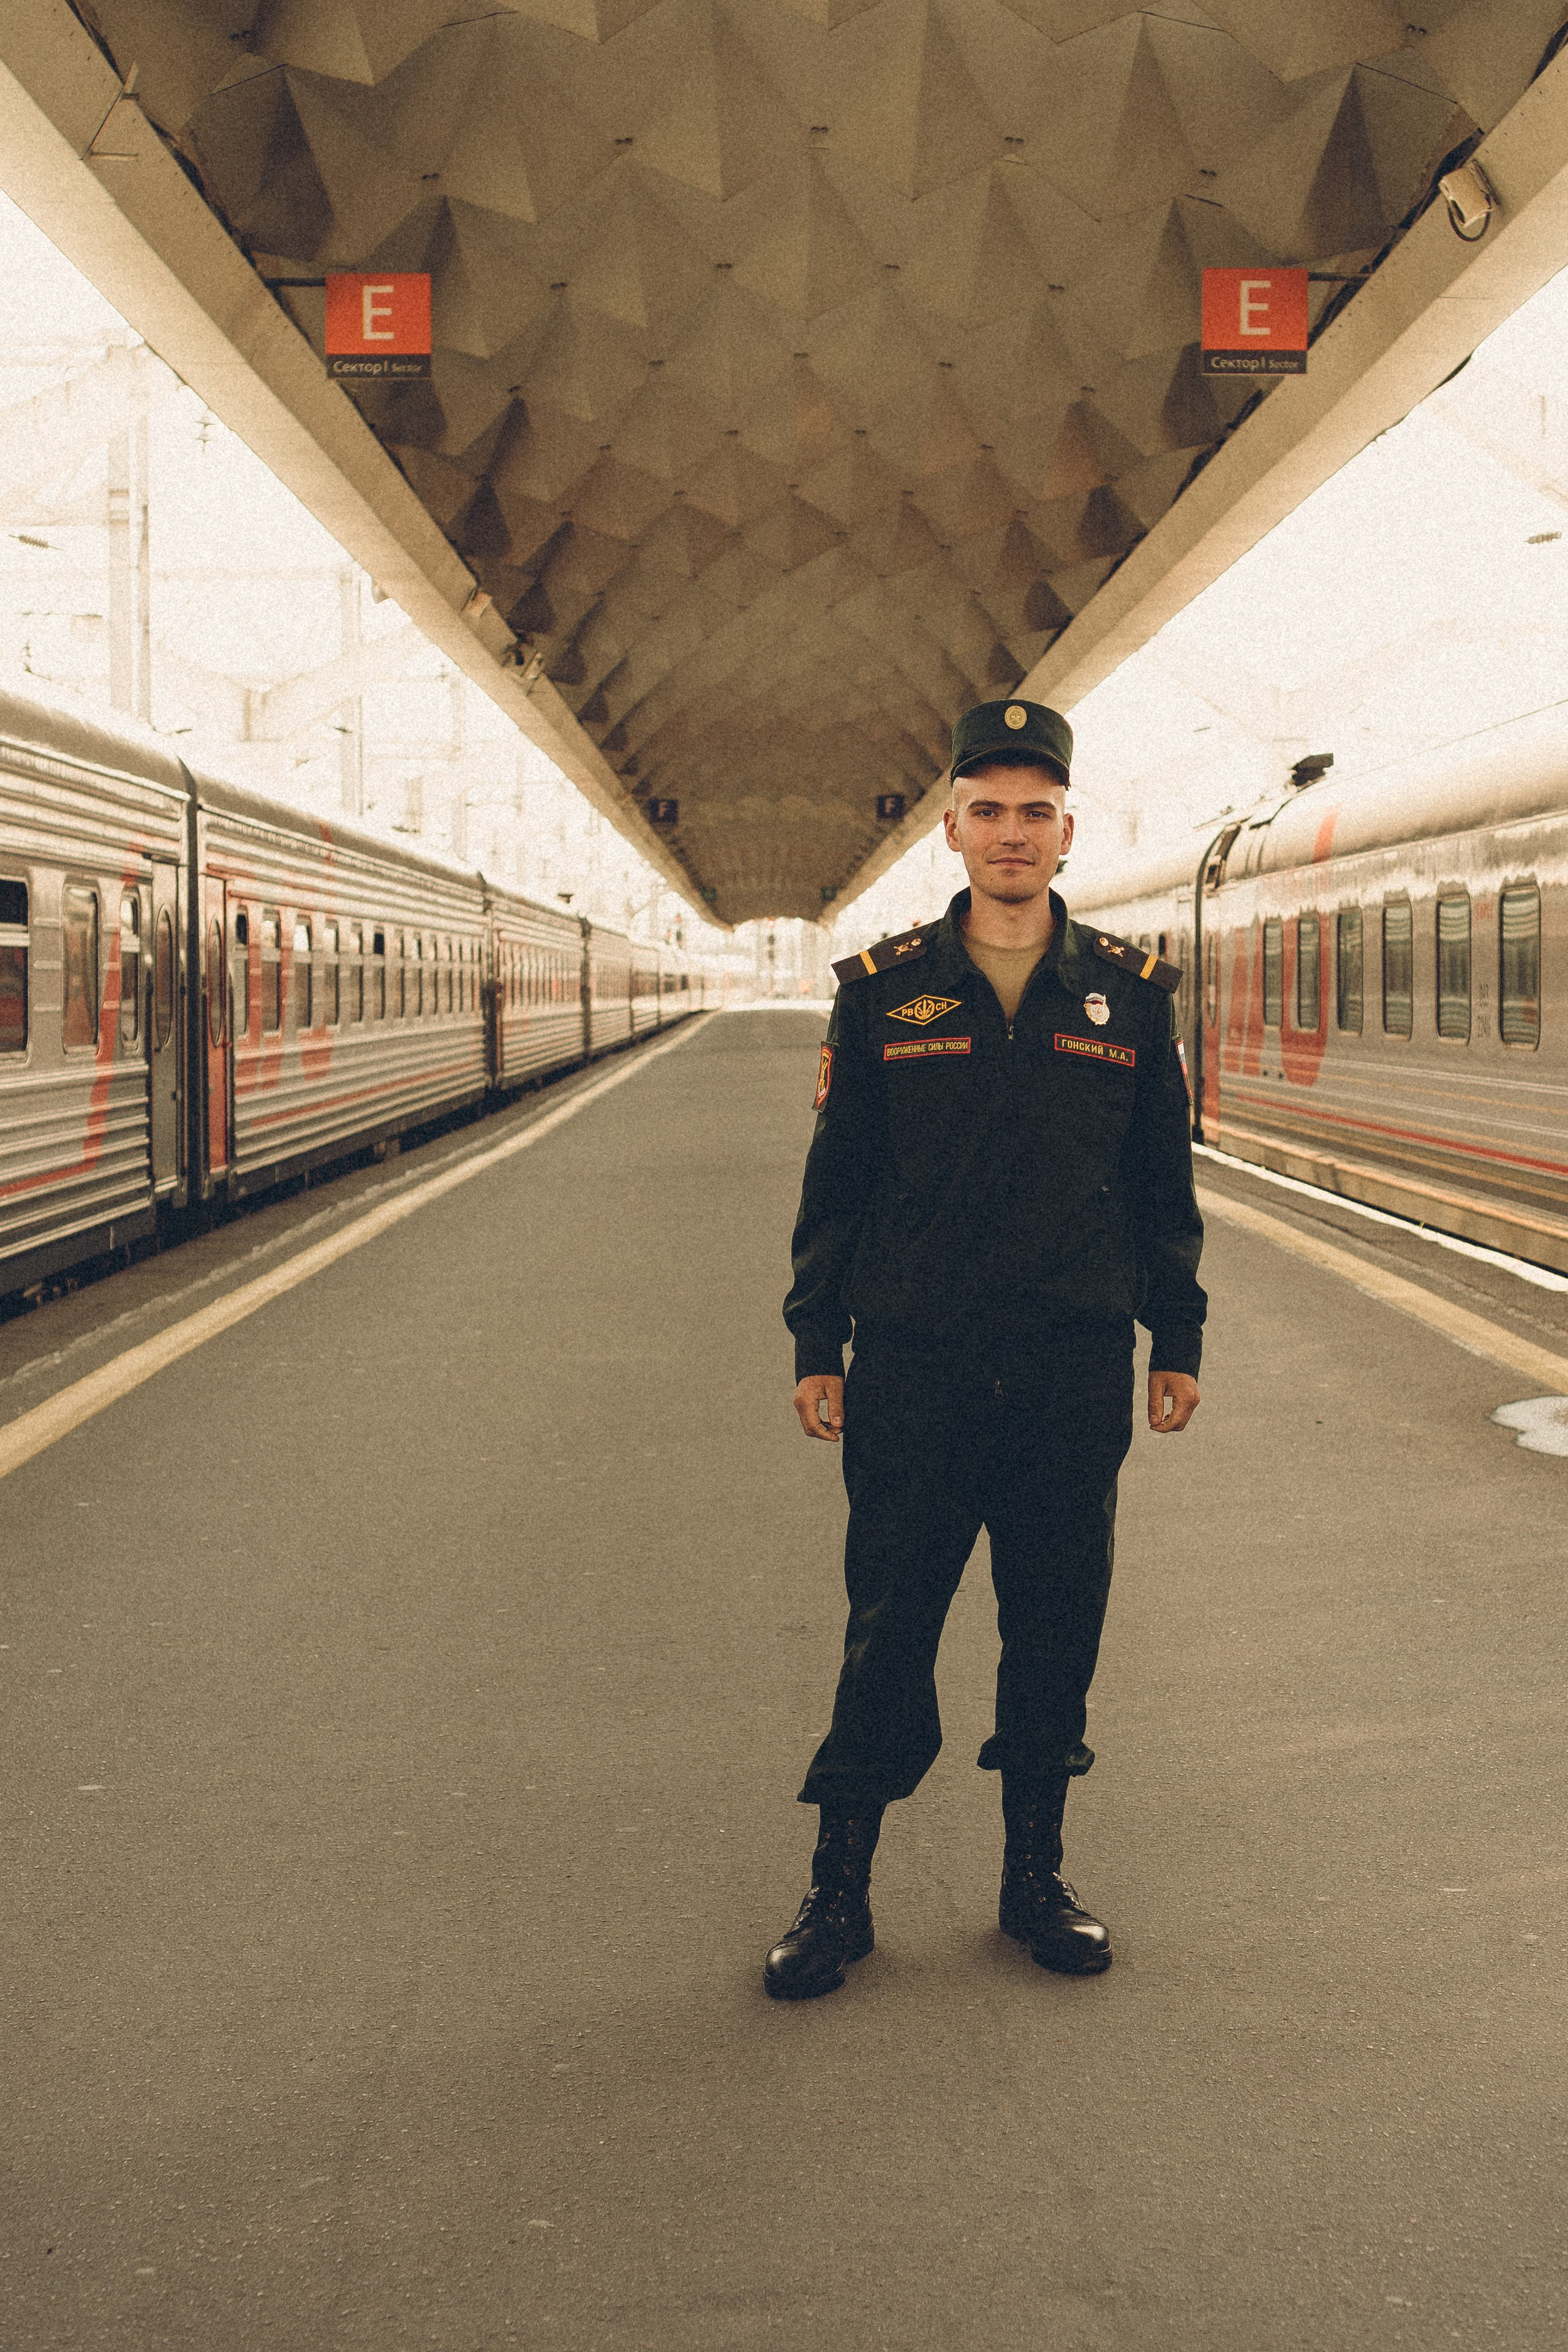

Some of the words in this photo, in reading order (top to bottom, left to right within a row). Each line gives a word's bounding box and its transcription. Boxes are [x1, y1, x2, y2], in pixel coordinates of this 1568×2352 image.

[363, 285, 395, 340] E
[1240, 280, 1272, 335] E
[333, 360, 383, 375] Сектор
[391, 363, 423, 372] Sector
[1210, 356, 1260, 371] Сектор
[1268, 359, 1300, 369] Sector
[659, 801, 668, 817] F
[885, 797, 895, 813] F
[886, 1044, 926, 1057] ВООРУЖЕННЫЕ
[928, 1042, 944, 1050] СИЛЫ
[946, 1041, 968, 1050] РОССИИ
[1061, 1039, 1104, 1055] ГОНСКИЙ
[1109, 1048, 1128, 1061] М.А.
